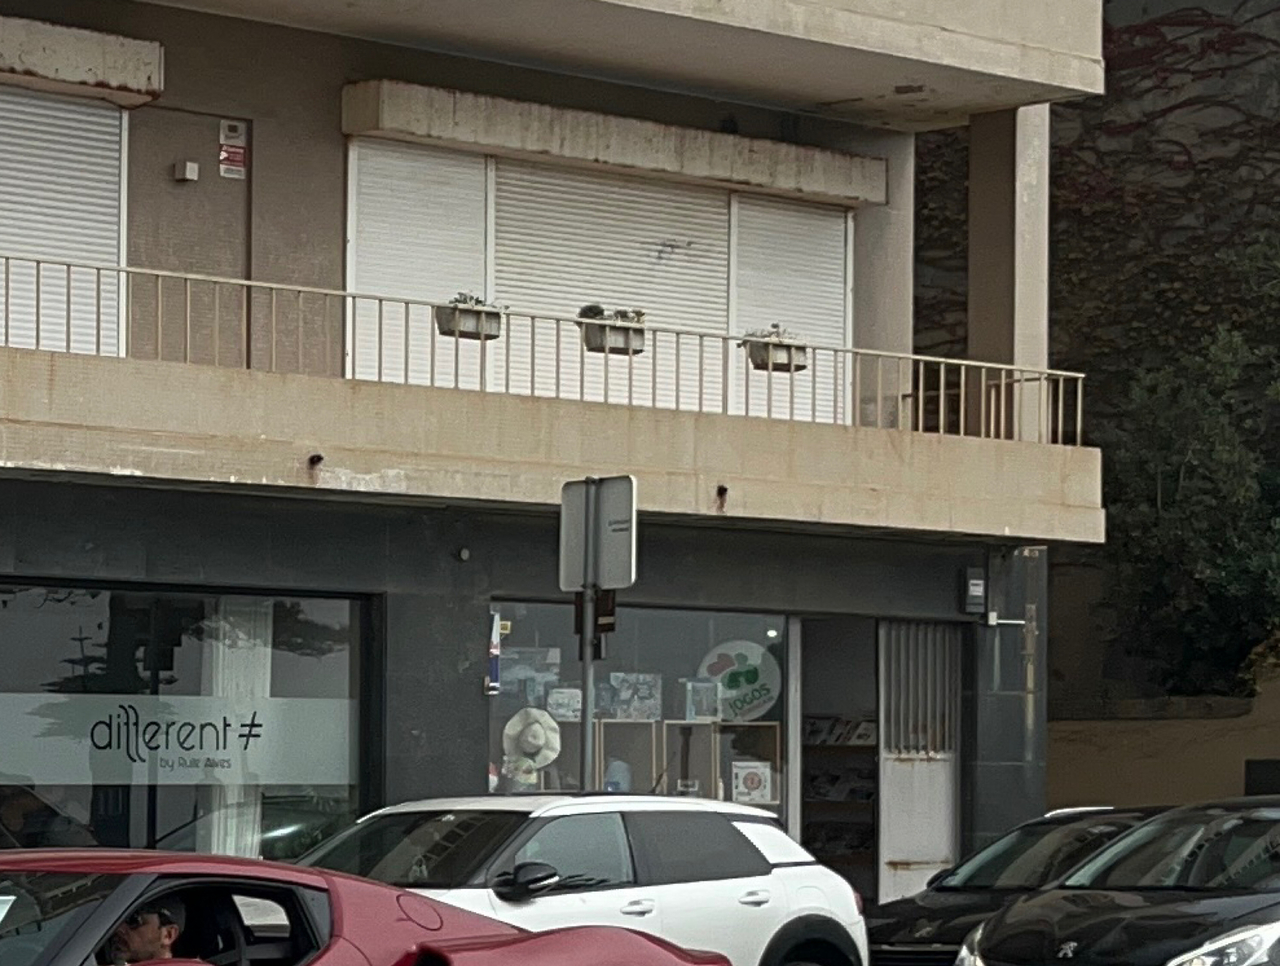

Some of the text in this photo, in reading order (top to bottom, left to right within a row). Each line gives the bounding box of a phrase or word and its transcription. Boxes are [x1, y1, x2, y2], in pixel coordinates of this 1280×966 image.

[728, 682, 771, 718] JOGOS
[90, 704, 232, 763] different
[159, 757, 175, 772] by
